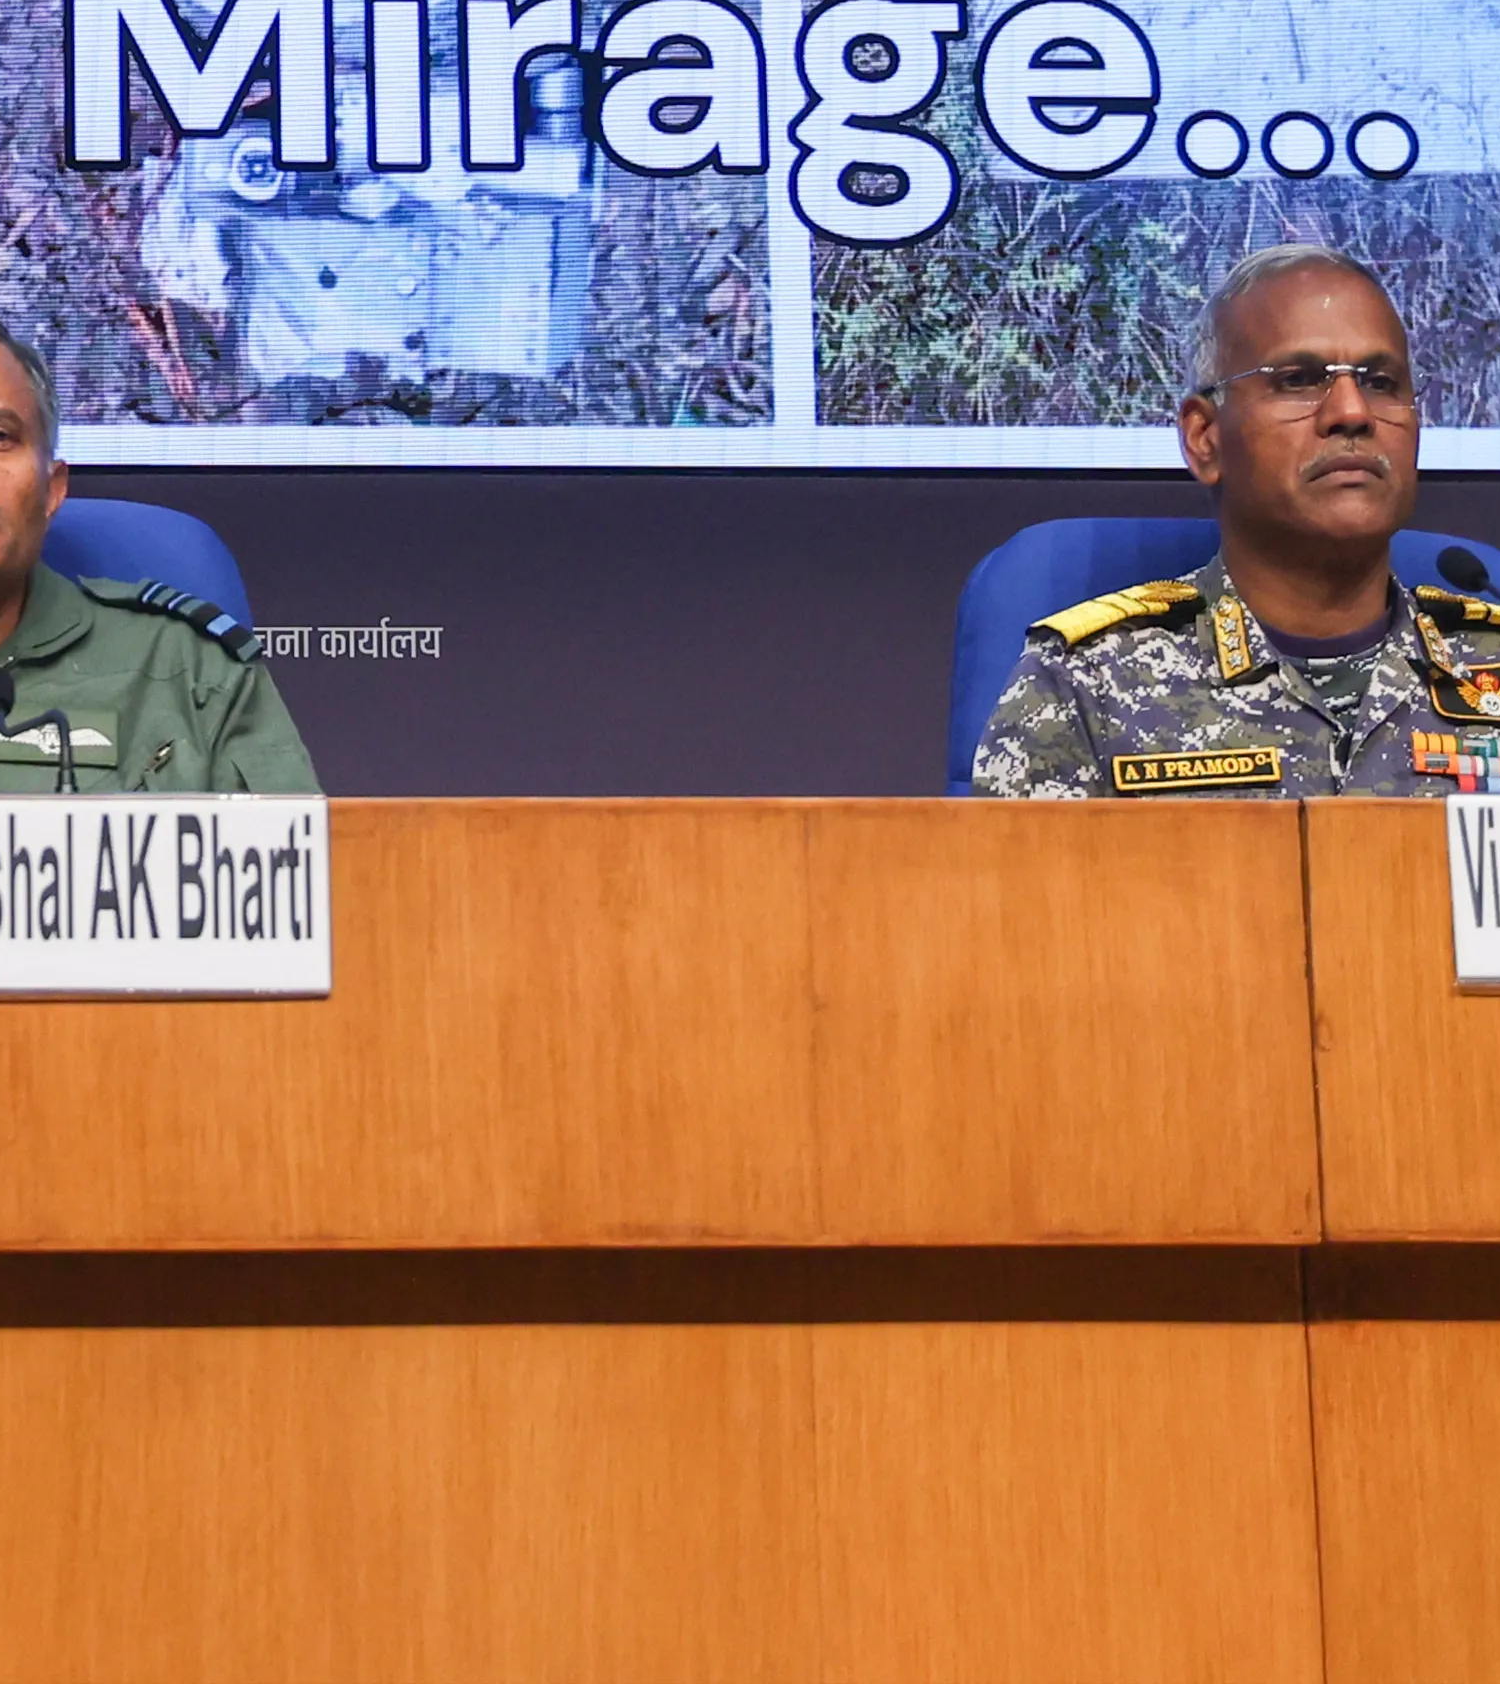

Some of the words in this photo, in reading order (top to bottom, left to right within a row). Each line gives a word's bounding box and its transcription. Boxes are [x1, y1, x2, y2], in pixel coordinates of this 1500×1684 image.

[254, 627, 313, 658] चना
[317, 616, 444, 659] कार्यालय
[1125, 763, 1140, 780] A
[1145, 761, 1159, 779] N
[1163, 756, 1254, 778] PRAMOD
[90, 814, 159, 939] AK
[177, 814, 312, 941] Bharti
